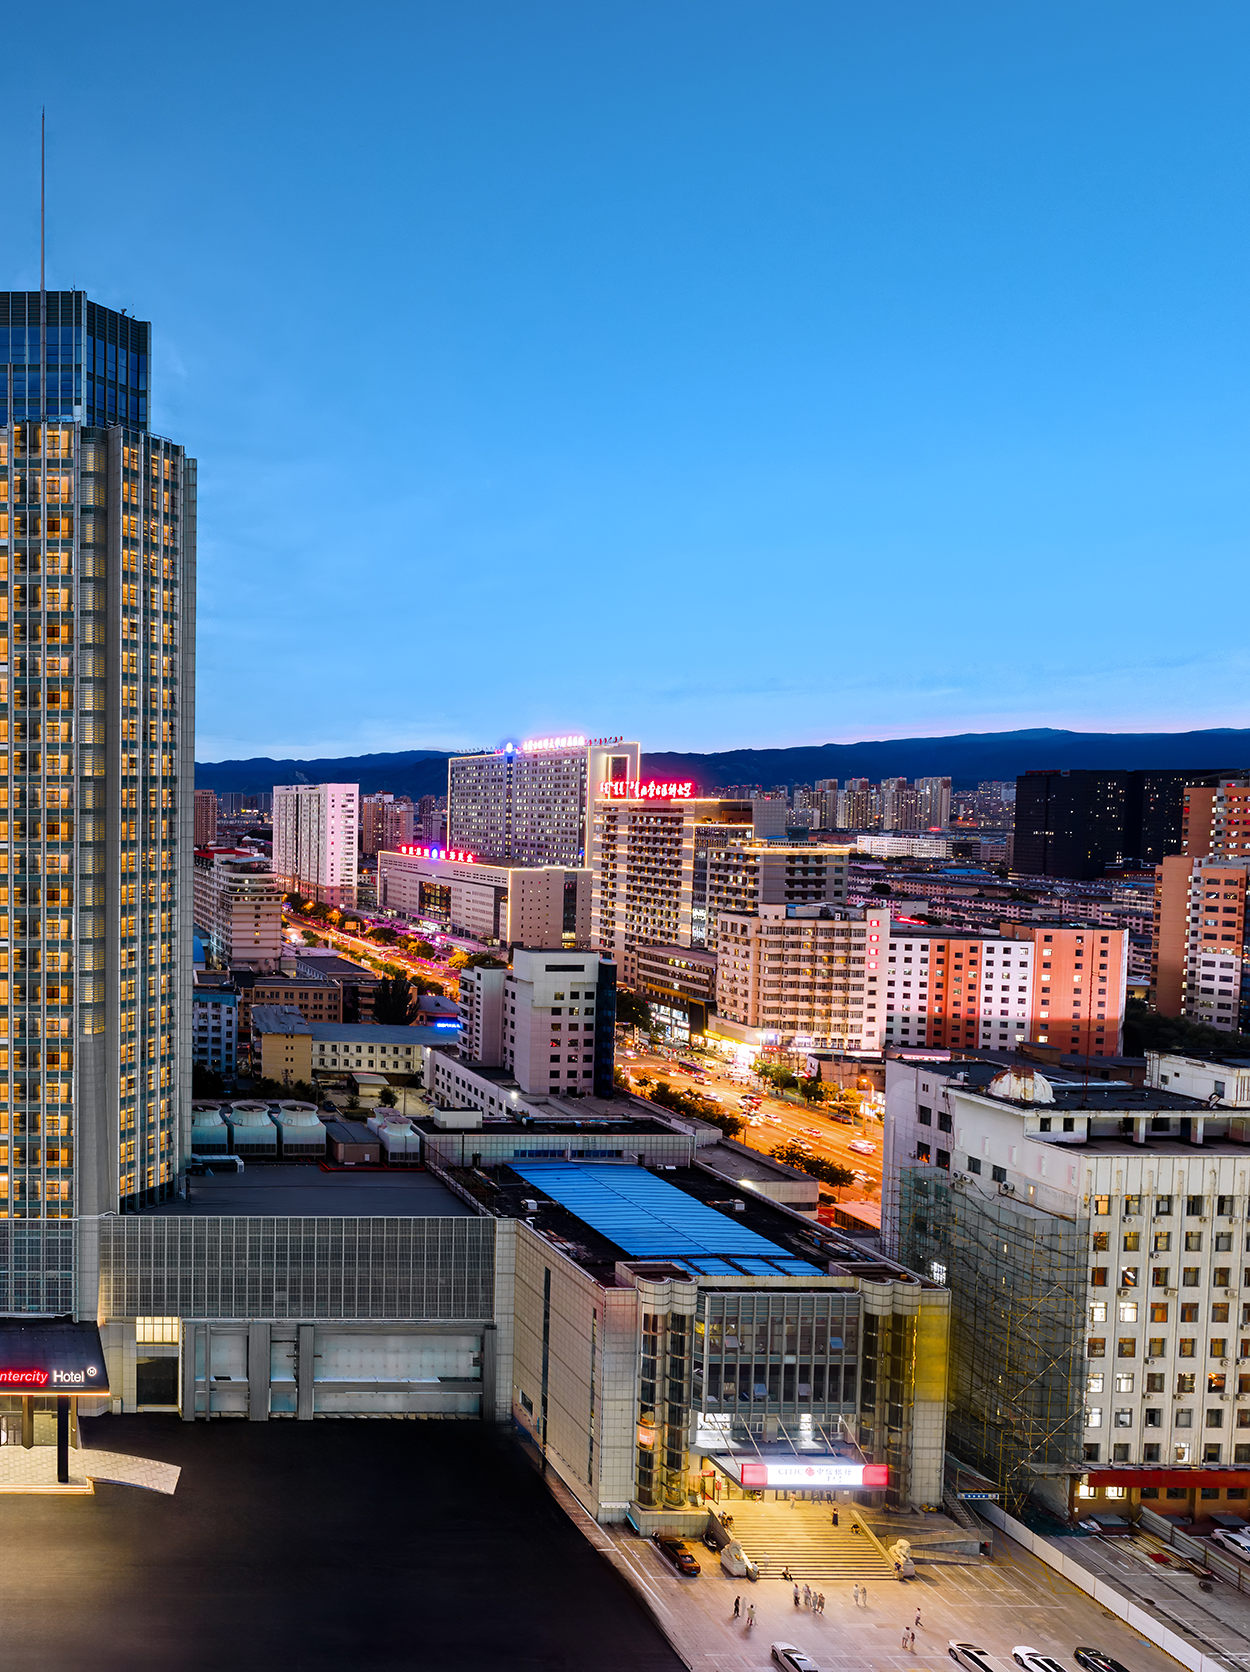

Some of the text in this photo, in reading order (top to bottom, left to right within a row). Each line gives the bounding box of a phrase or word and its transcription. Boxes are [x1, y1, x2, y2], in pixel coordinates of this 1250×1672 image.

[53, 1370, 84, 1383] Hotel
[777, 1468, 804, 1476] CITIC
[816, 1468, 852, 1476] 中信银行
